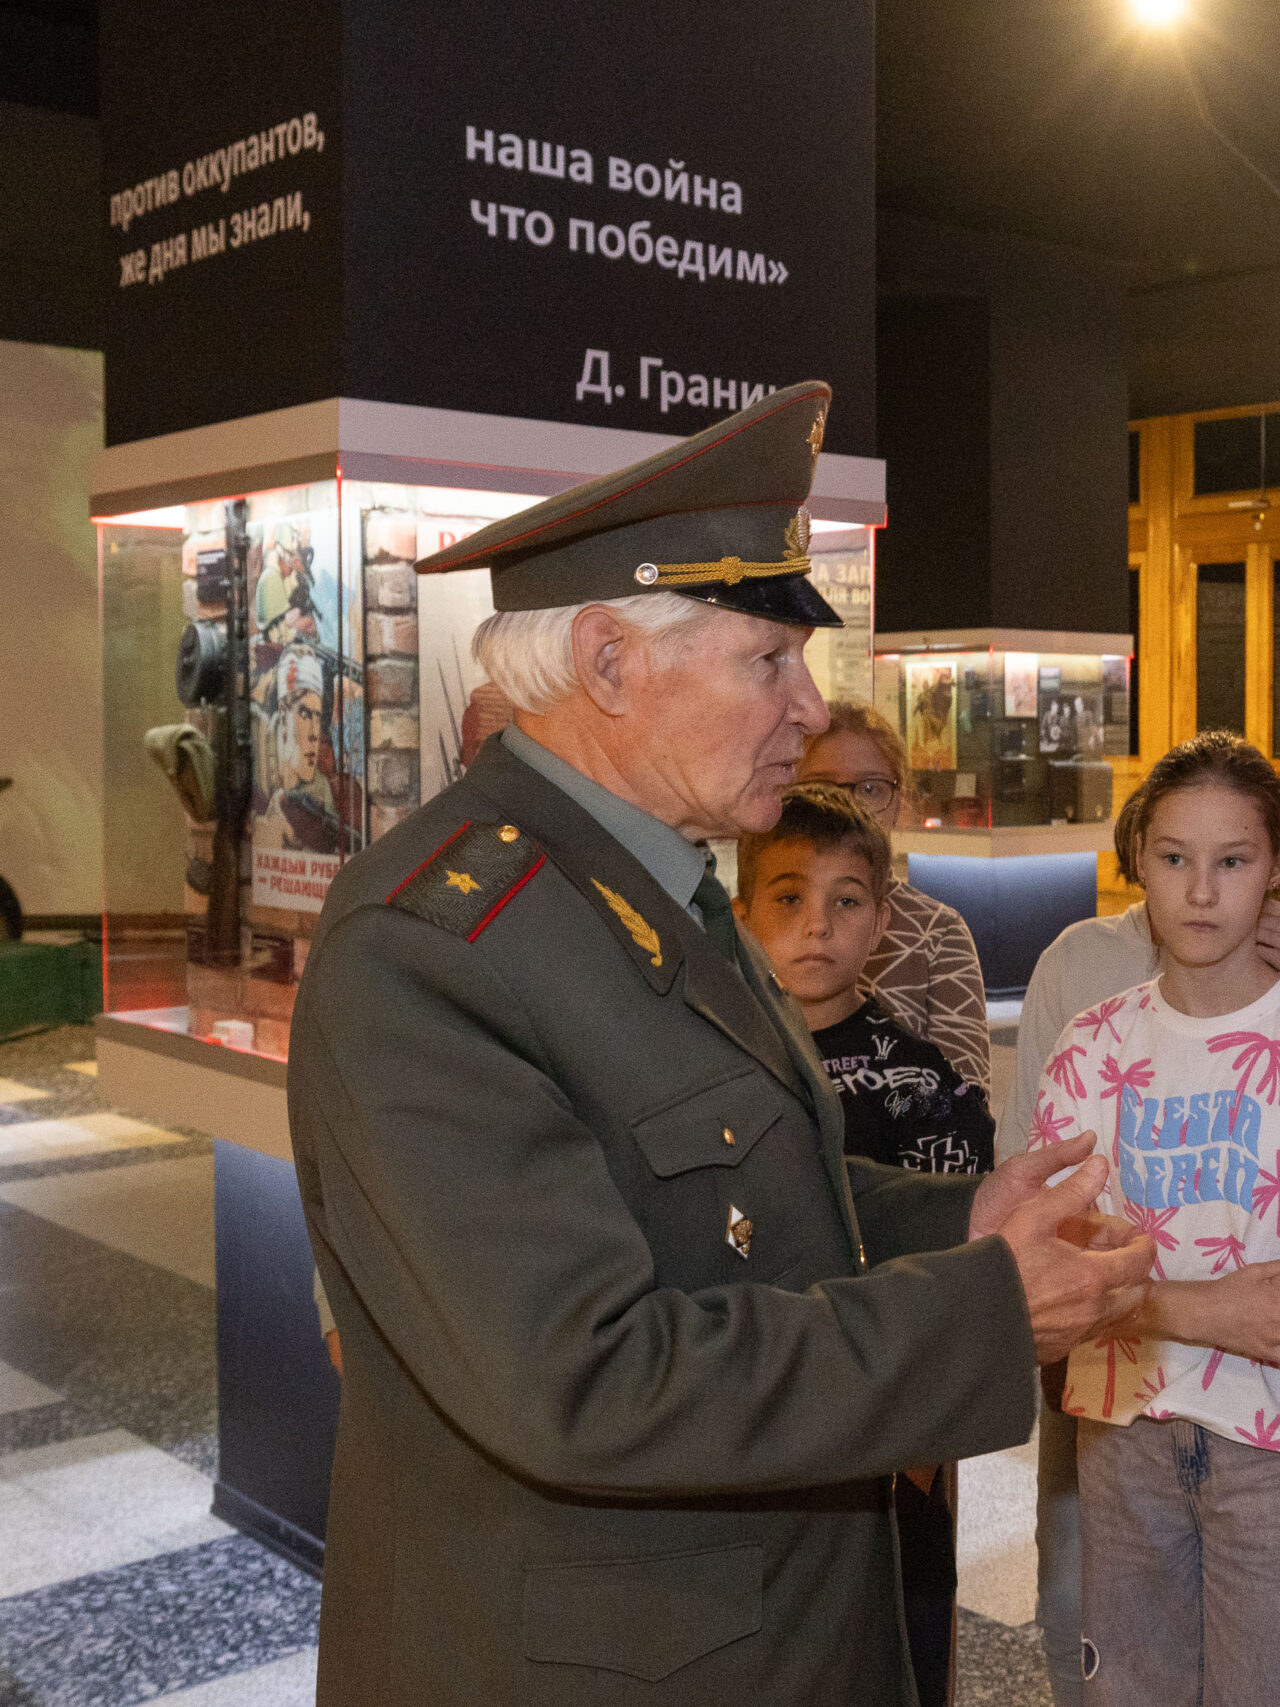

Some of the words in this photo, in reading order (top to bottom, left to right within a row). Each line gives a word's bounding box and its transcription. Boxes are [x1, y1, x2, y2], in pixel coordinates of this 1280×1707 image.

[110, 168, 180, 233] против
[182, 111, 325, 196] оккупантов,
[465, 125, 593, 184] наша
[608, 156, 743, 215] война
[120, 250, 147, 288] же
[149, 233, 188, 285] дня
[191, 218, 226, 263] мы
[230, 190, 310, 248] знали,
[470, 199, 554, 246] что
[568, 216, 789, 285] победим»
[576, 348, 625, 402] Д.
[310, 860, 341, 879] РУБЕ
[821, 1055, 871, 1073] TREET
[1119, 1143, 1259, 1215] BEACH
